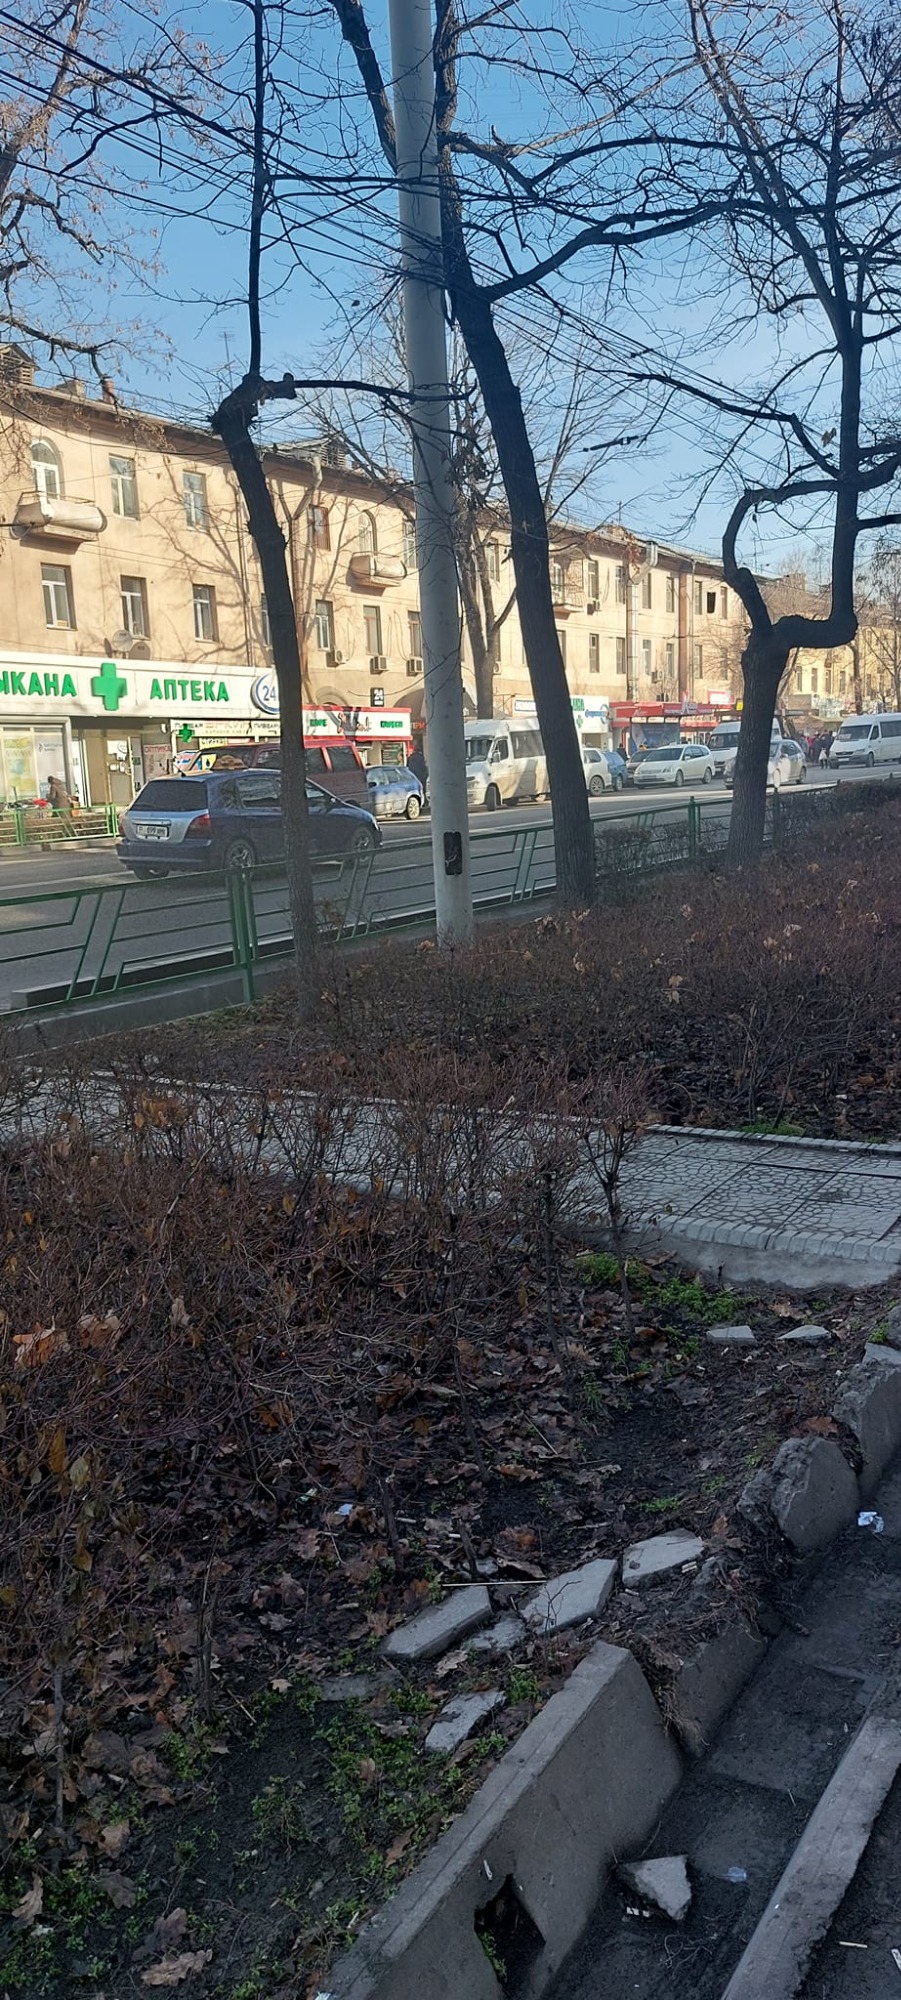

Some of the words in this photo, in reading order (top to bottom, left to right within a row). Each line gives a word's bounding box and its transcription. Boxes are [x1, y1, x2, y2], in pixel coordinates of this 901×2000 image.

[150, 678, 229, 702] АПТЕКА
[262, 685, 277, 702] 24
[374, 688, 384, 700] 24
